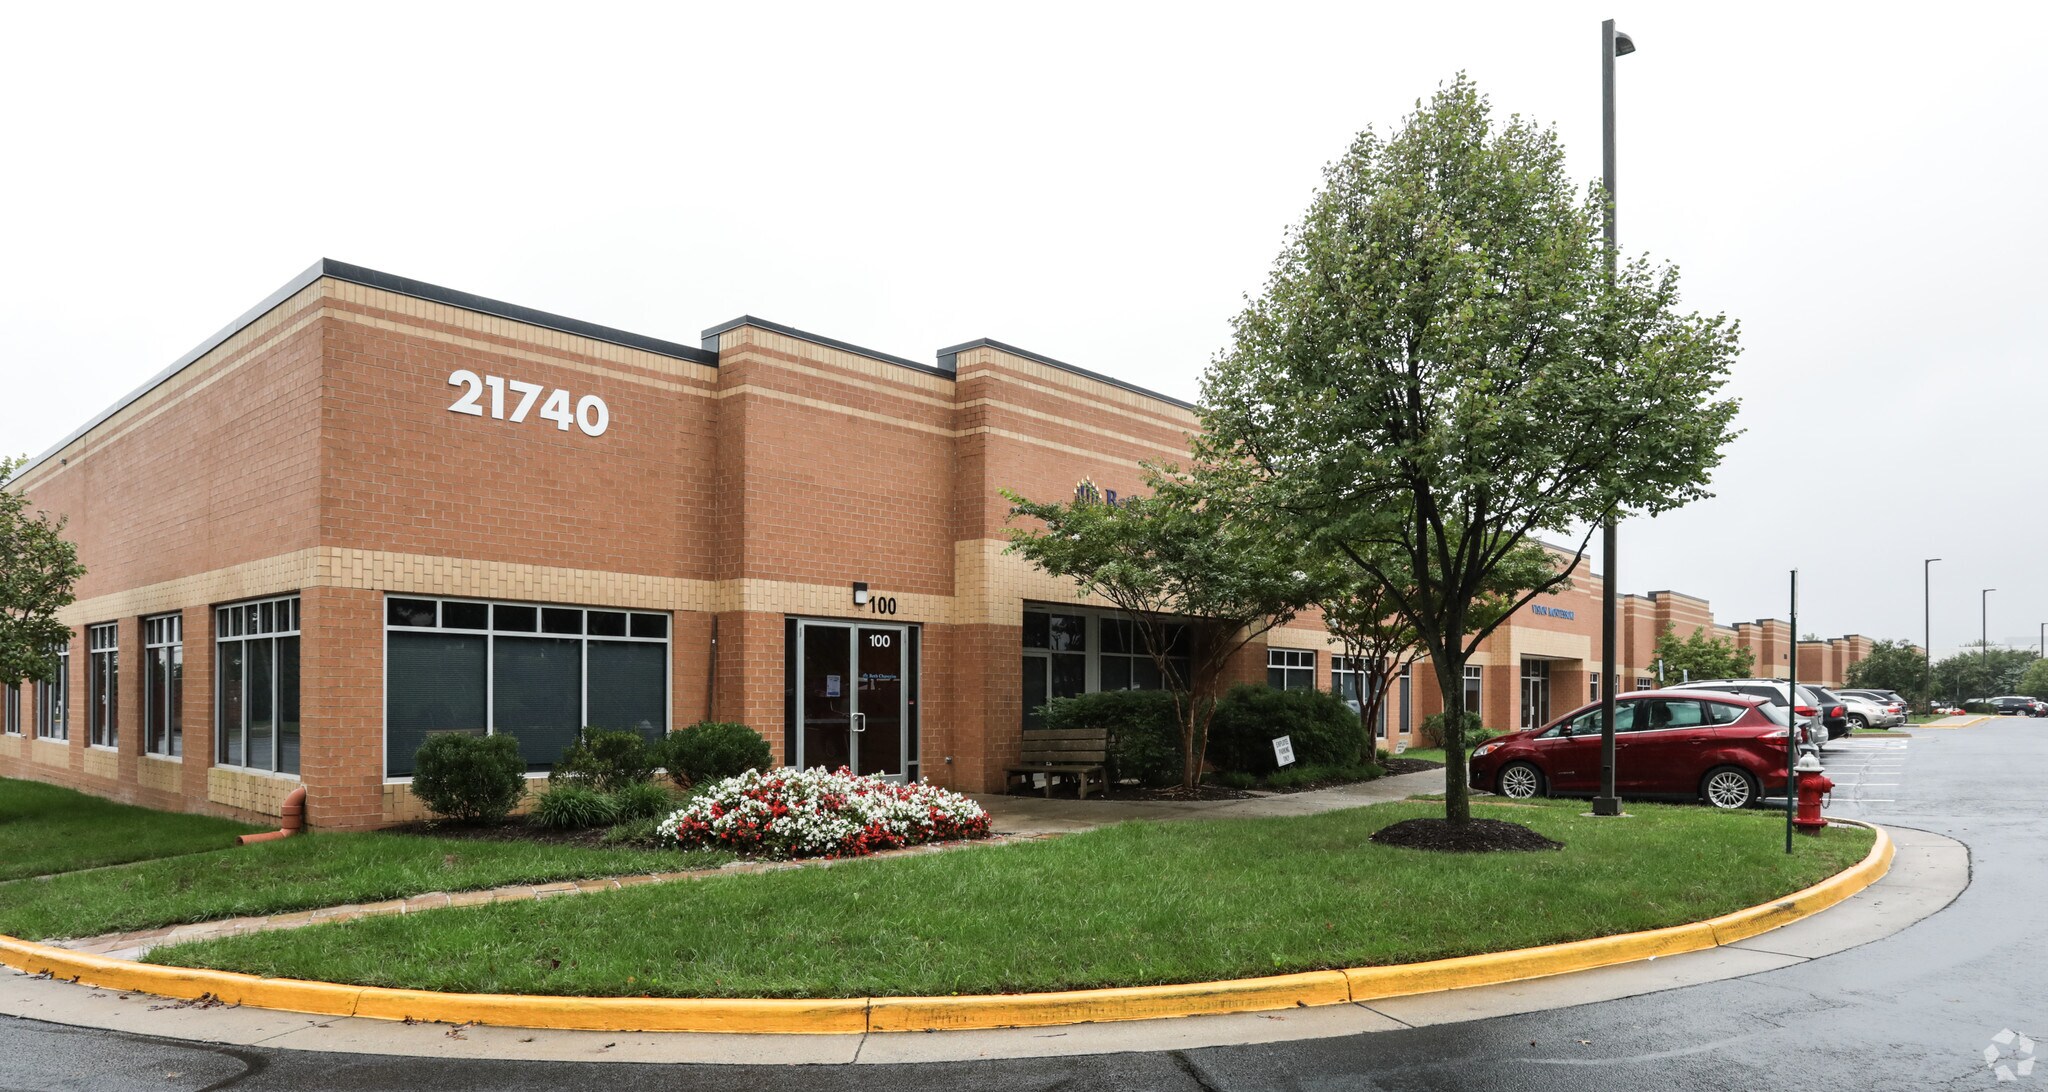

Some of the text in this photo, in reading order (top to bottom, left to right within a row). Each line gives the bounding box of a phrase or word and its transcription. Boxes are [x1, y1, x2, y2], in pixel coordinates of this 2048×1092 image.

[447, 369, 610, 437] 21740
[868, 595, 897, 615] 100
[869, 634, 891, 648] 100
